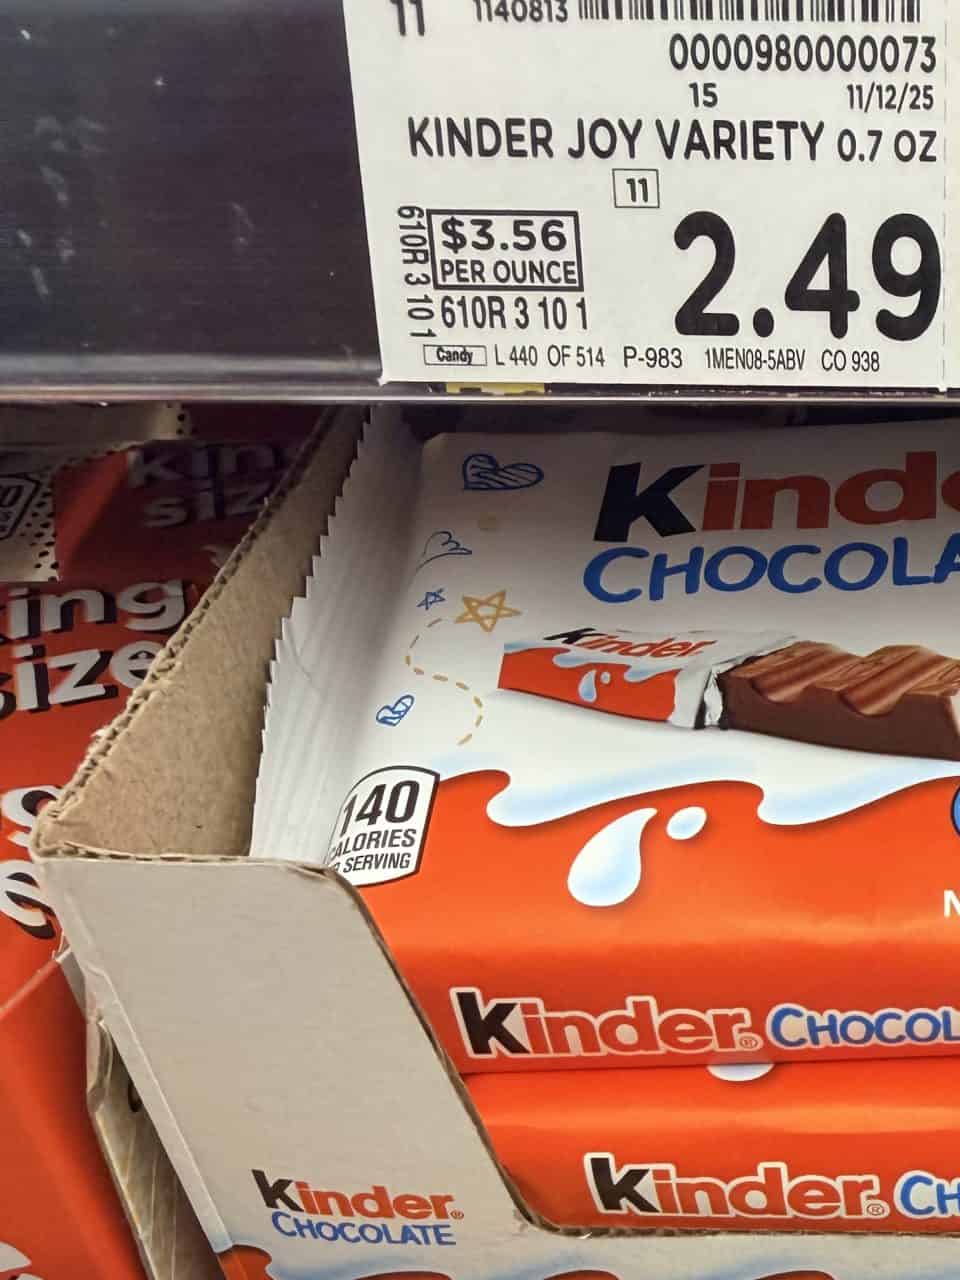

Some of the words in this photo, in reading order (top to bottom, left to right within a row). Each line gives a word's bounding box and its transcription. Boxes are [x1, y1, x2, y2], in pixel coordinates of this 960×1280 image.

[669, 36, 937, 74] 0000980000073
[688, 83, 717, 107] 15
[846, 83, 934, 113] 11/12/25
[408, 117, 553, 158] KINDER
[567, 118, 643, 160] JOY
[655, 119, 825, 162] VARIETY
[837, 129, 882, 162] 0.7
[893, 130, 937, 162] OZ
[625, 178, 648, 203] 11
[397, 207, 430, 264] 610R
[440, 216, 567, 253] $3.56
[440, 260, 486, 283] PER
[492, 260, 577, 285] OUNCE
[674, 211, 942, 342] 2.49
[440, 296, 505, 331] 610R
[514, 296, 529, 331] 3
[538, 296, 567, 331] 10
[436, 347, 473, 366] Candy
[509, 345, 538, 367] 440
[547, 345, 572, 367] OF
[576, 345, 606, 367] 514
[623, 348, 682, 368] P-983
[821, 350, 846, 371] CO
[851, 350, 880, 372] 938
[544, 627, 717, 659] Kinder
[339, 780, 420, 838] 140
[343, 852, 412, 873] SERVING
[456, 991, 752, 1055] Kinder
[252, 1169, 455, 1221] Kinder
[590, 1157, 878, 1216] Kinder
[272, 1211, 456, 1246] CHOCOLATE
